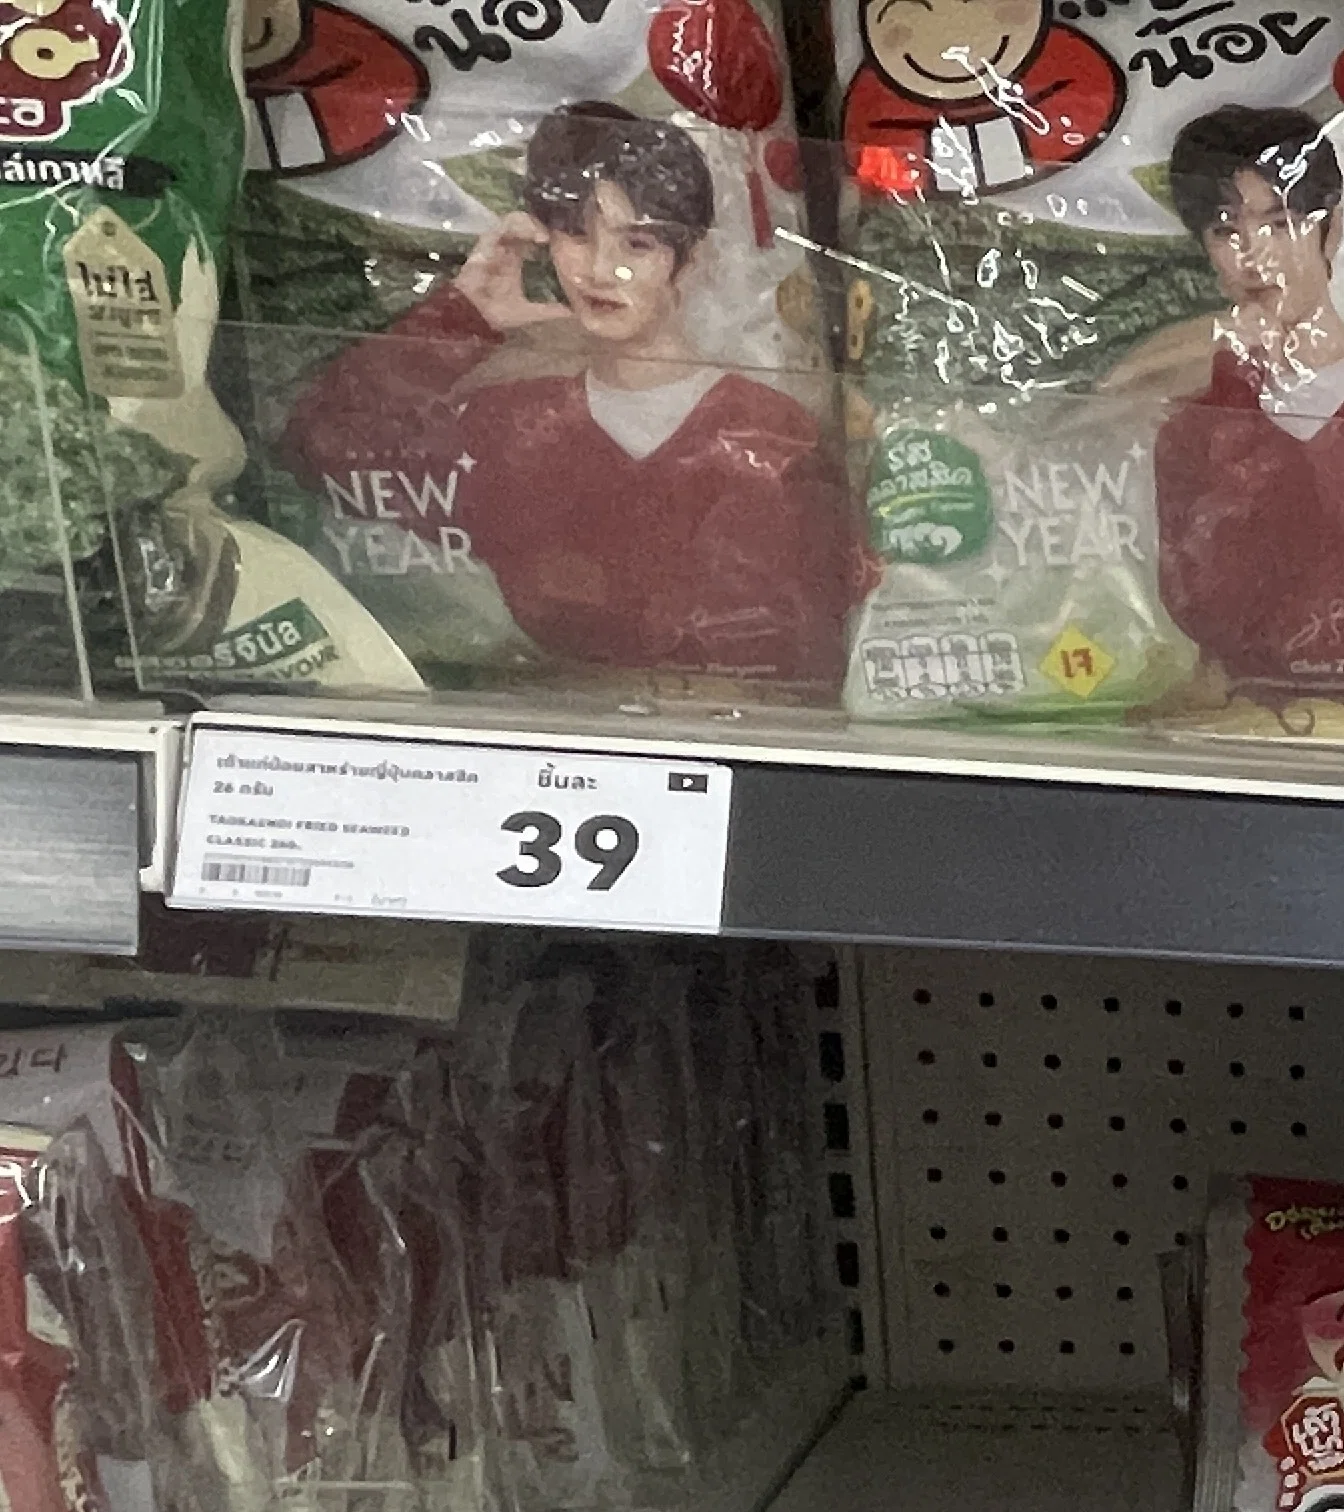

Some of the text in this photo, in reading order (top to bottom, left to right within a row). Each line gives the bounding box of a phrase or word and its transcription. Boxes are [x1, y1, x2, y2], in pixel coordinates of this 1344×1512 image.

[323, 469, 459, 520] NEW
[1004, 459, 1131, 513] NEW
[323, 525, 478, 576] YEAR
[998, 512, 1146, 567] YEAR
[536, 762, 599, 791] ชิ้นละ
[495, 809, 641, 893] 39
